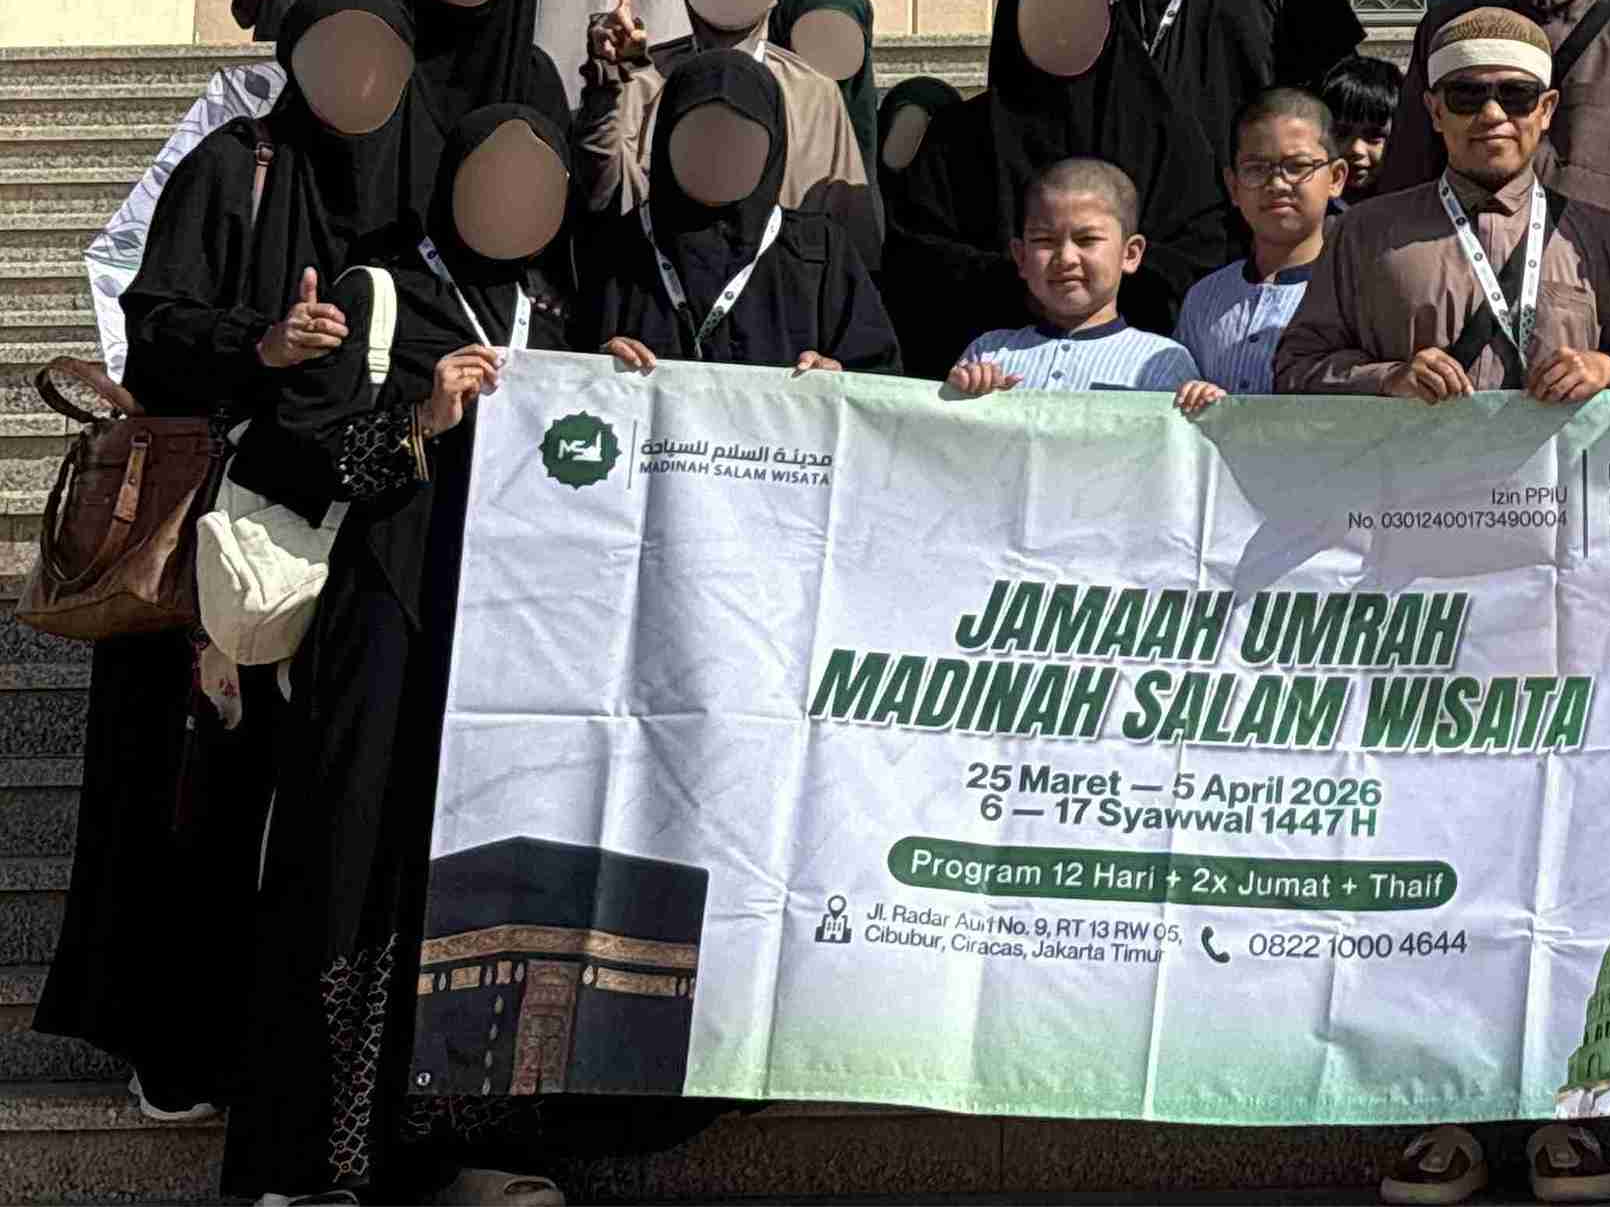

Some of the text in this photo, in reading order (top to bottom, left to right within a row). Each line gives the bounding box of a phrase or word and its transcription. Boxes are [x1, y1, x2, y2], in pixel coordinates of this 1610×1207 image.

[640, 437, 833, 467] مدينة السلام للسياحة
[639, 460, 831, 486] MADINAH SALAM WISATA
[1491, 487, 1568, 505] Izin PPIU
[953, 579, 1471, 673] JAMAAH UMRAH
[807, 646, 1595, 755] MADINAH SALAM WISATA
[966, 762, 1013, 792] 25
[1019, 765, 1122, 796] Maret
[1172, 773, 1195, 799] 5
[1200, 774, 1283, 809] April
[1290, 778, 1383, 806] 2026
[980, 793, 1003, 821] 6
[1055, 798, 1092, 825] 17
[1098, 797, 1253, 834] Syawwal
[1261, 808, 1344, 836] 1447
[910, 849, 1042, 886] Program
[1052, 861, 1083, 886] 12
[1093, 862, 1156, 889] Hari
[1191, 867, 1228, 893] 2x
[1238, 870, 1331, 898] Jumat
[1369, 872, 1445, 899] Thaif
[864, 924, 1165, 963] Cibubur, Ciracas, Jakarta Timur
[867, 903, 886, 921] Jl.
[892, 904, 950, 928] Radar
[998, 916, 1030, 935] No.
[1034, 918, 1051, 939] 9,
[1056, 918, 1085, 937] RT
[1089, 920, 1109, 939] 13
[1114, 921, 1151, 940] RW
[1153, 923, 1183, 944] 05,
[1249, 930, 1468, 958] 0822 1000 4644
